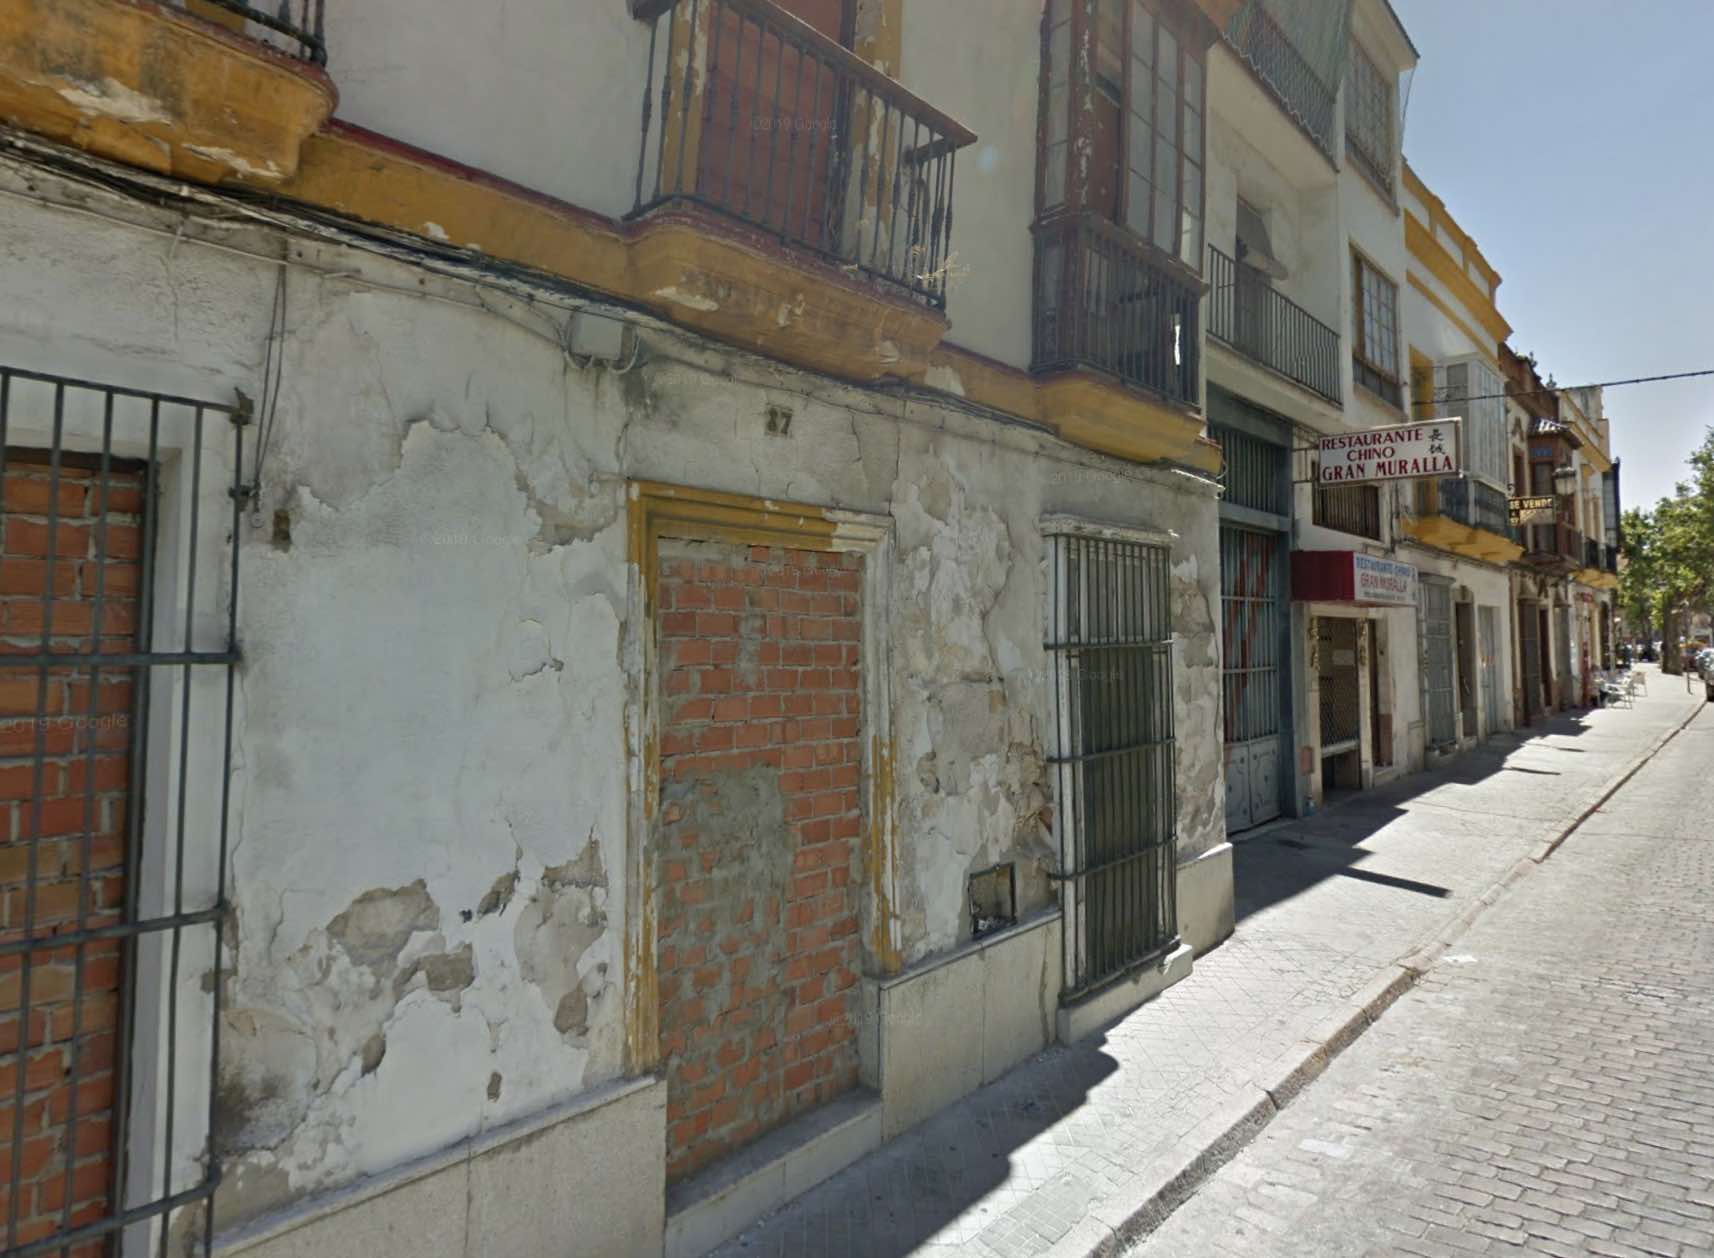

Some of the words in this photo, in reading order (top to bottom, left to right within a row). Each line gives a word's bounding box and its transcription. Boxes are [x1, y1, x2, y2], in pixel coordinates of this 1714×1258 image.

[1322, 428, 1423, 450] RESTAURANTE
[1347, 446, 1395, 462] CHINO
[1322, 463, 1366, 481] GRAN
[1375, 455, 1453, 477] MURALLA
[1522, 498, 1552, 509] VENDE
